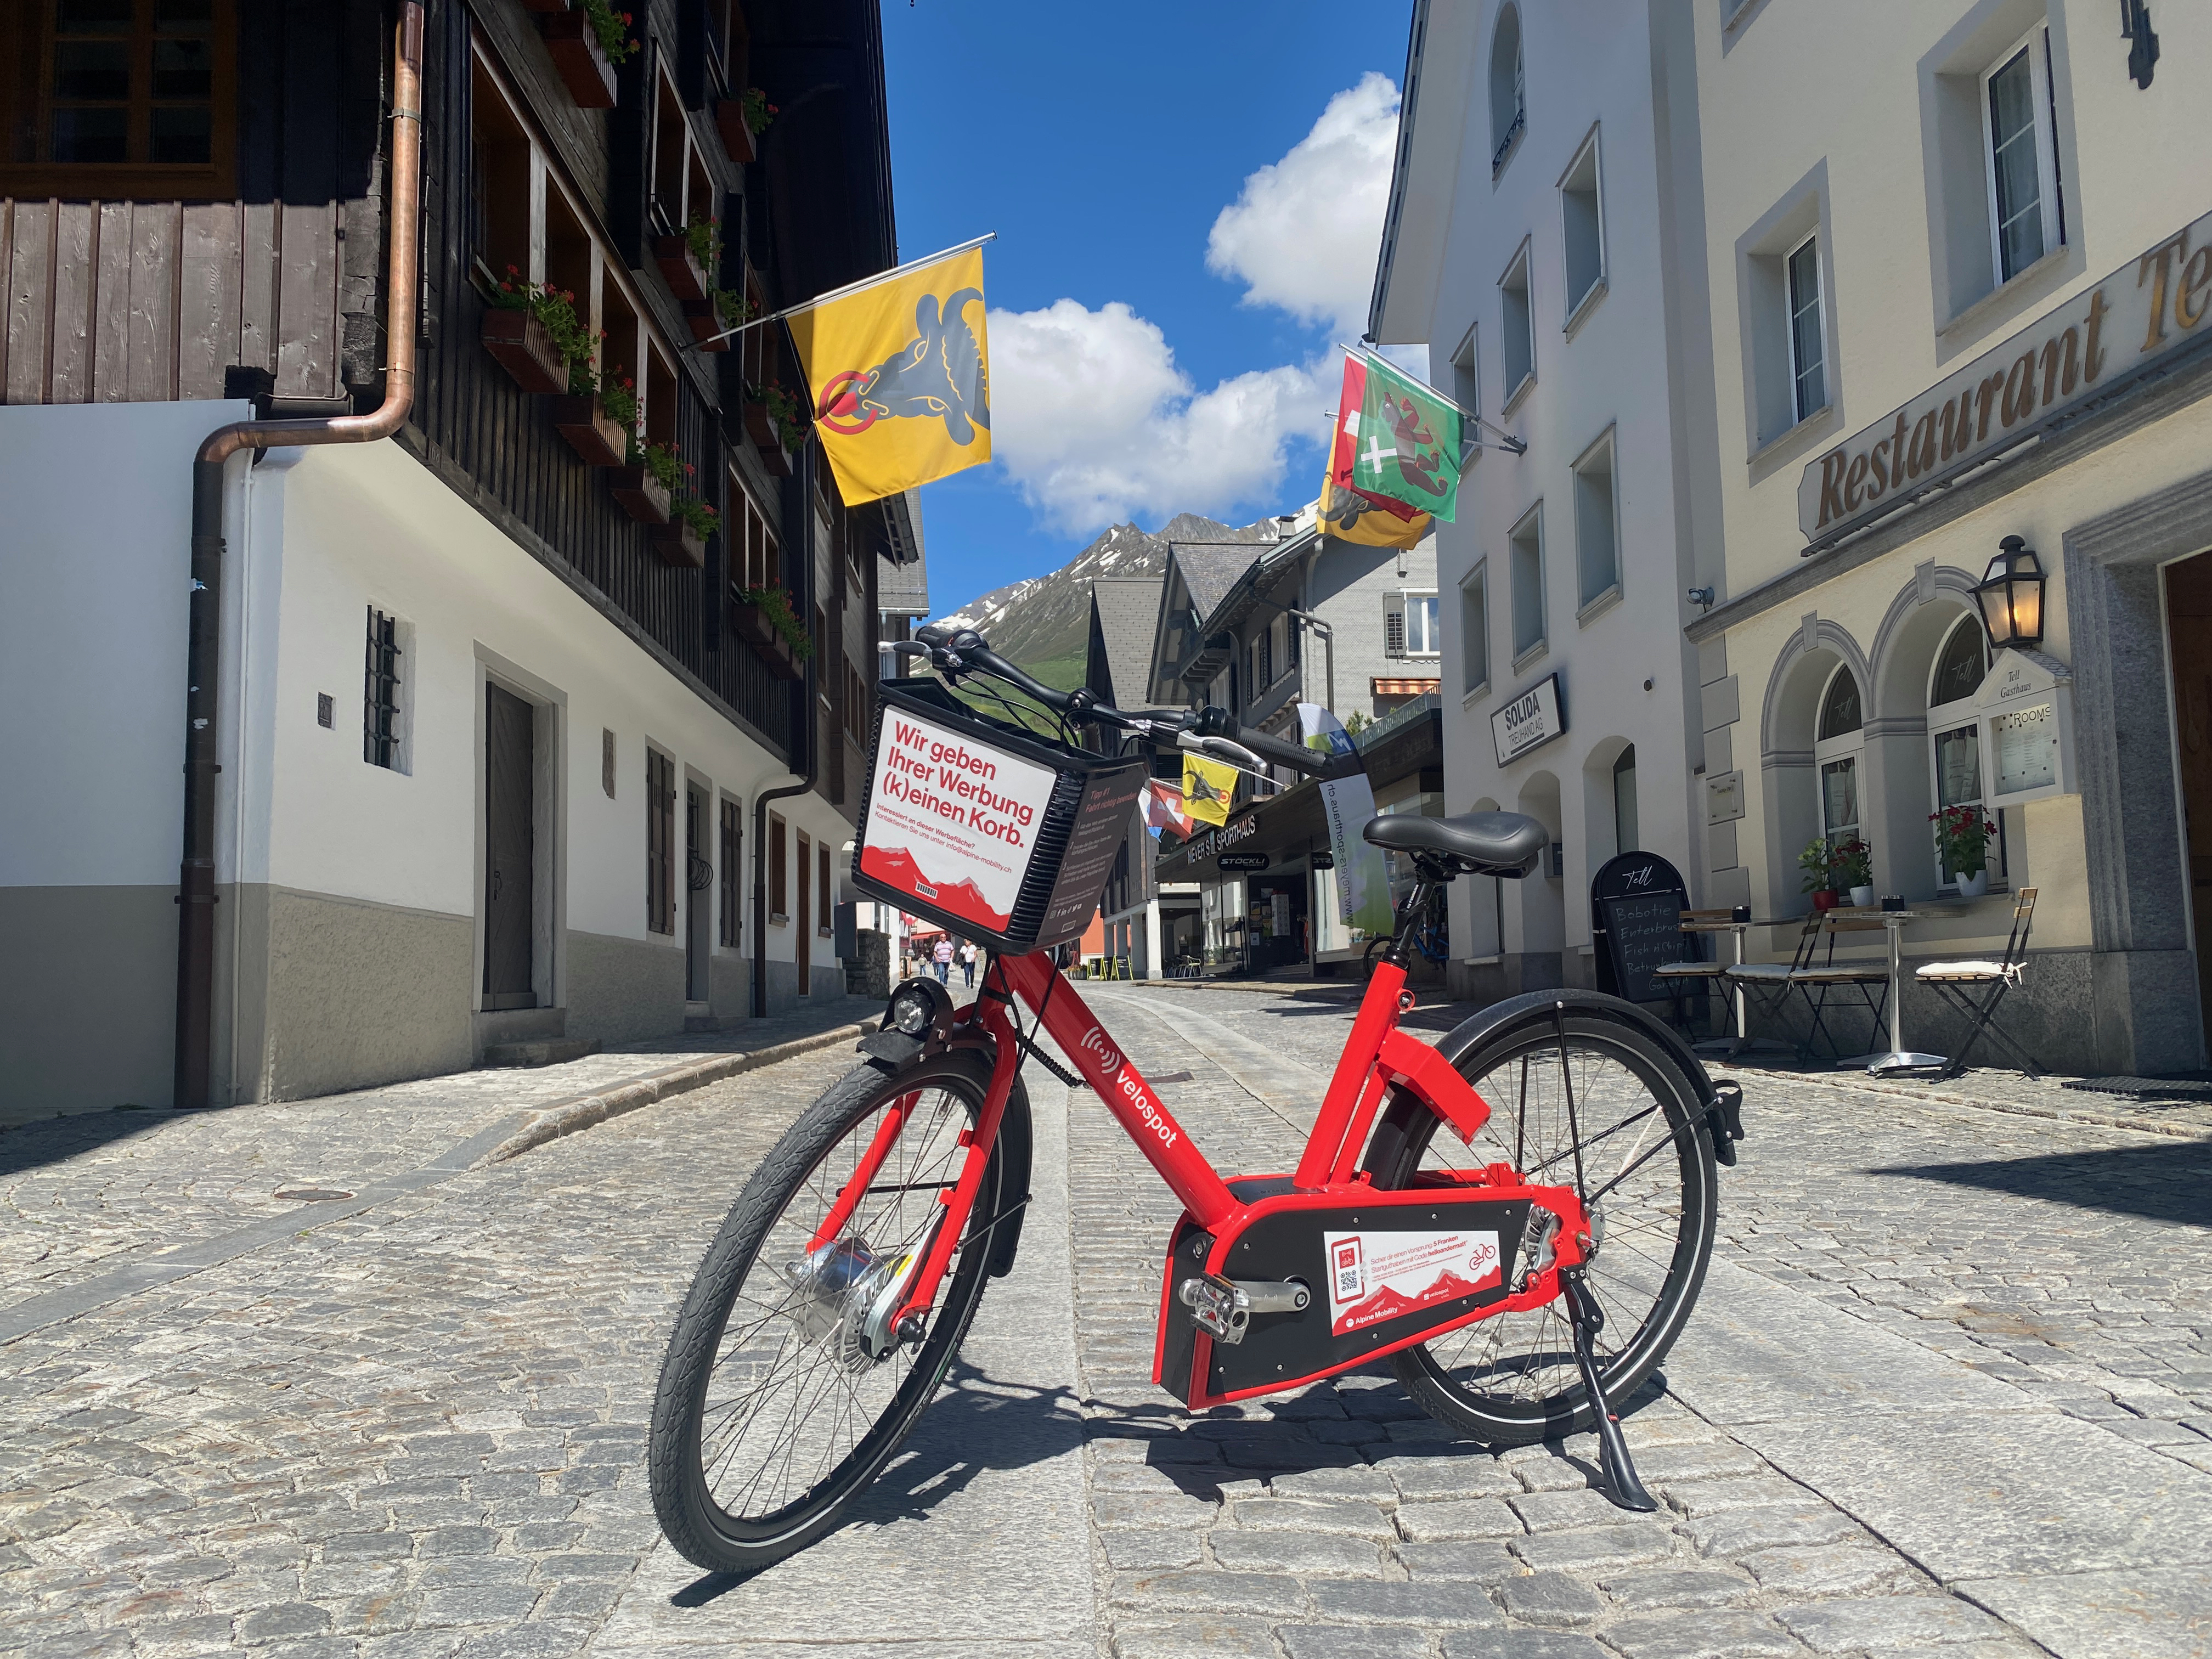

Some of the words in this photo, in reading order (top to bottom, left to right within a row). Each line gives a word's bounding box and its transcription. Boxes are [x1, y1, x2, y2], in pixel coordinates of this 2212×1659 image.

[1815, 289, 2109, 530] Restaurant
[1951, 653, 1976, 688] Tell
[2008, 669, 2019, 682] Tell
[2001, 683, 2031, 698] Gasthaus
[1505, 692, 1541, 731] SOLIDA
[1835, 694, 1854, 725] Tell
[2014, 707, 2051, 725] ROOMS
[1508, 722, 1535, 747] TREUHAND
[1536, 717, 1543, 732] AG
[896, 720, 928, 752] Wir
[929, 742, 996, 780] geben
[887, 746, 934, 782] Ihrer
[940, 766, 1034, 826] Werbung
[1091, 790, 1103, 800] Tipp
[883, 771, 965, 823] (k)einen
[968, 807, 1025, 848] Korb.
[877, 803, 908, 821] Interessiert
[916, 821, 934, 832] dieser
[935, 828, 975, 849] Werbefläche?
[1216, 815, 1255, 850] SPORTHAUS
[874, 810, 909, 830] Kontaktieren
[909, 826, 918, 834] Sie
[919, 831, 929, 839] uns
[930, 836, 945, 846] unter
[946, 842, 1012, 873] info@alpine-mobility.ch
[1622, 865, 1652, 889] Tell
[1624, 943, 1649, 958] Fish
[1116, 1069, 1177, 1148] velospot
[1370, 1256, 1386, 1265] Sicher
[1437, 1235, 1458, 1245] Franken
[1371, 1259, 1406, 1273] Startguthaben
[1414, 1253, 1428, 1261] Code
[1429, 1288, 1449, 1298] velospot
[956, 1293, 978, 1341] SCHWALBE
[1355, 1313, 1374, 1325] Alpine
[1375, 1307, 1398, 1319] Mobility
[922, 1383, 935, 1405] ROAD
